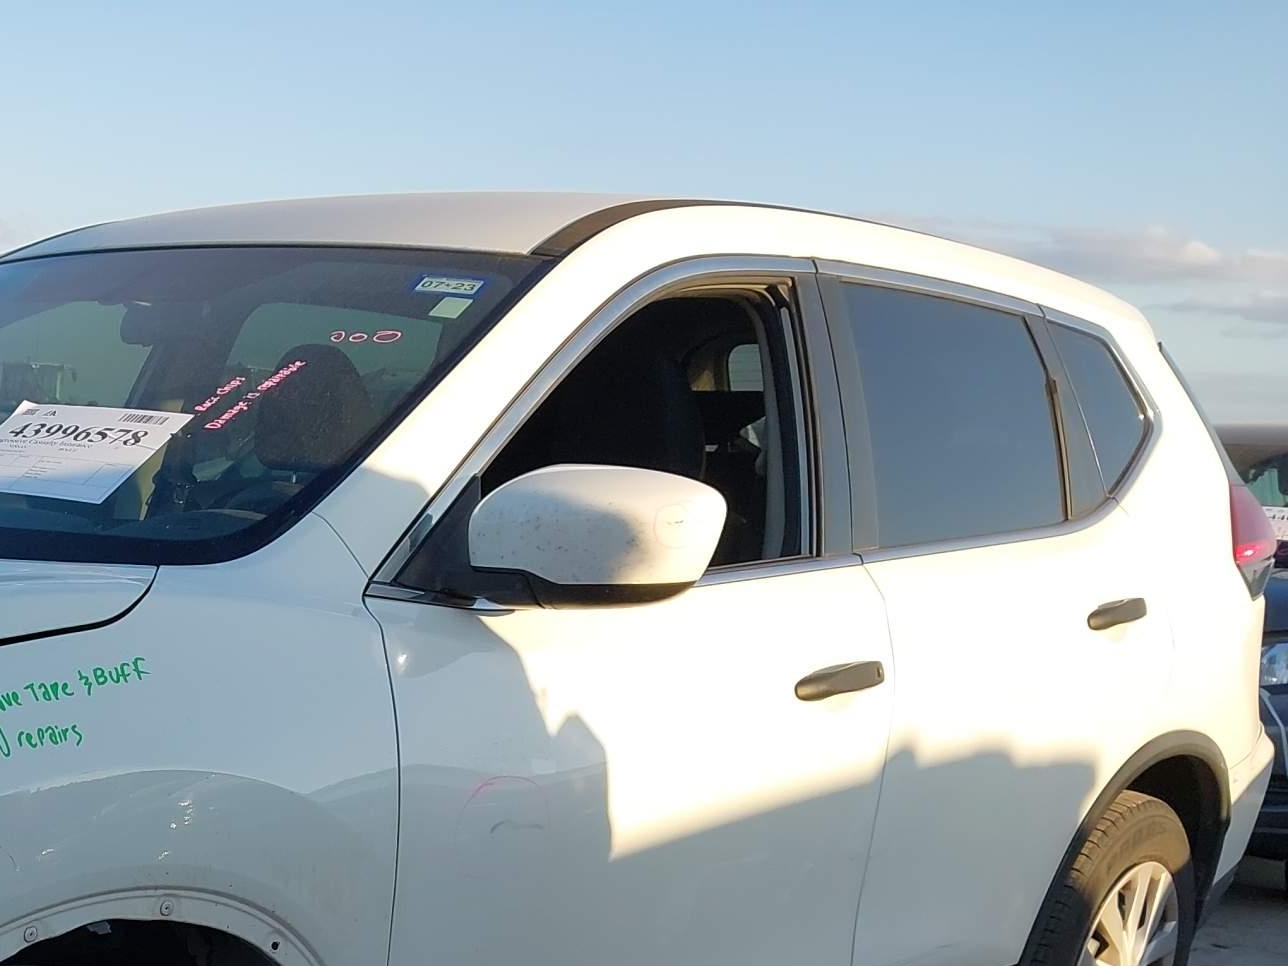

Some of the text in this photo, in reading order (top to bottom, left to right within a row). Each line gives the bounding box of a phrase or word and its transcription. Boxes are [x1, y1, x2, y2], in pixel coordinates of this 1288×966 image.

[203, 400, 249, 429] Damage
[9, 422, 148, 446] 43996578
[24, 680, 74, 703] Tape
[17, 724, 83, 749] repairs
